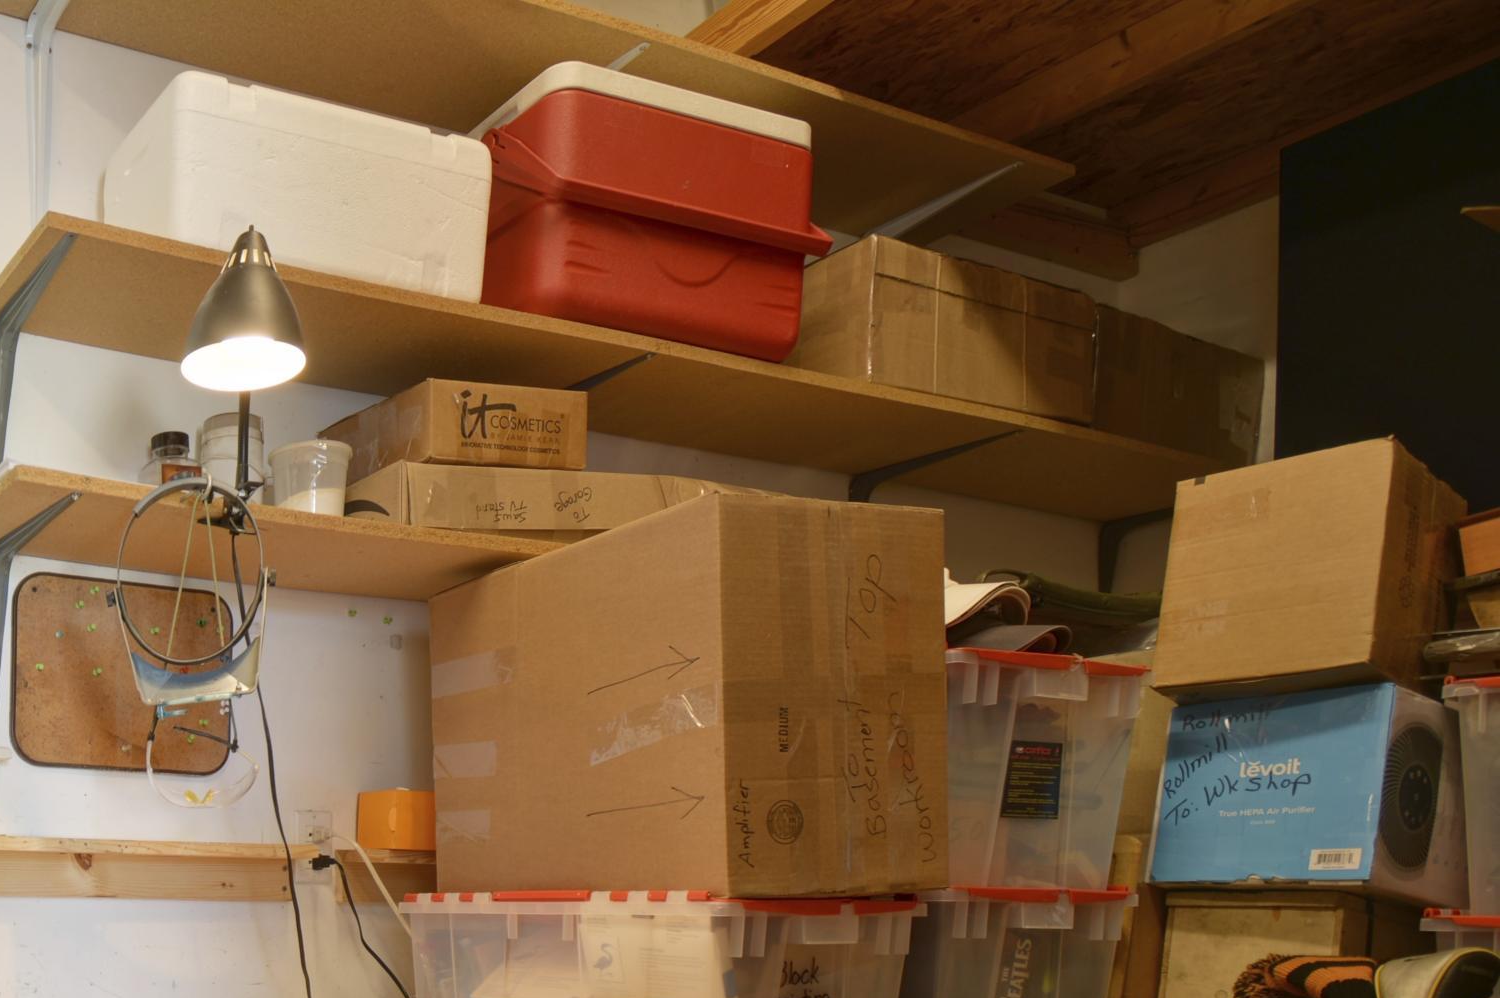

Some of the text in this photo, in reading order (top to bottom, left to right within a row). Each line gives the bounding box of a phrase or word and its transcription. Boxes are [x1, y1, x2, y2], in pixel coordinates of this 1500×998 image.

[490, 414, 561, 434] COSMETICS
[554, 487, 593, 512] Garage
[573, 507, 590, 523] To
[844, 554, 897, 650] Top
[778, 706, 789, 753] MEDIUM
[837, 697, 887, 837] Basement
[842, 753, 866, 804] To
[732, 778, 755, 869] Amplifier
[1164, 798, 1199, 826] To:
[1219, 805, 1316, 818] True HEPA Air Purifier
